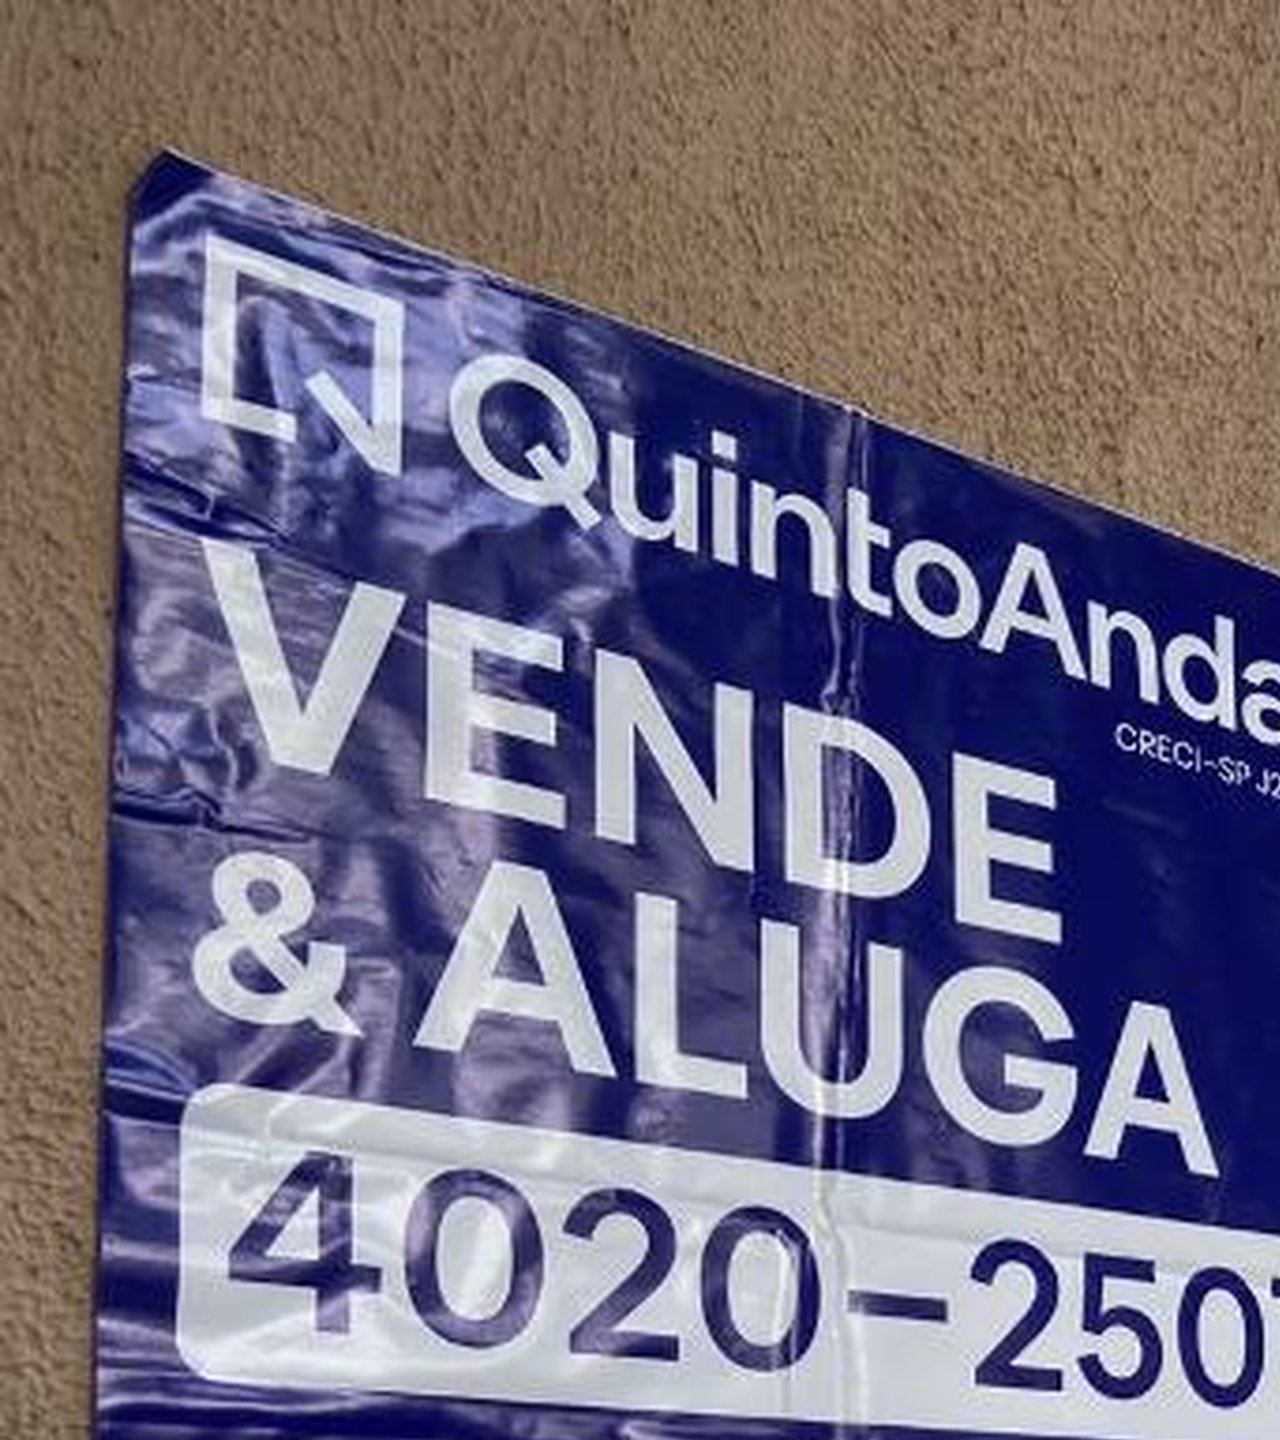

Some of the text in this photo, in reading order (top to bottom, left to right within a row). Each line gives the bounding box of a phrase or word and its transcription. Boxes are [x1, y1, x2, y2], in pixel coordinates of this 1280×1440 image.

[202, 538, 1063, 945] VENDE
[1114, 722, 1252, 785] CRECI-SP
[191, 850, 1220, 1179] & ALUGA
